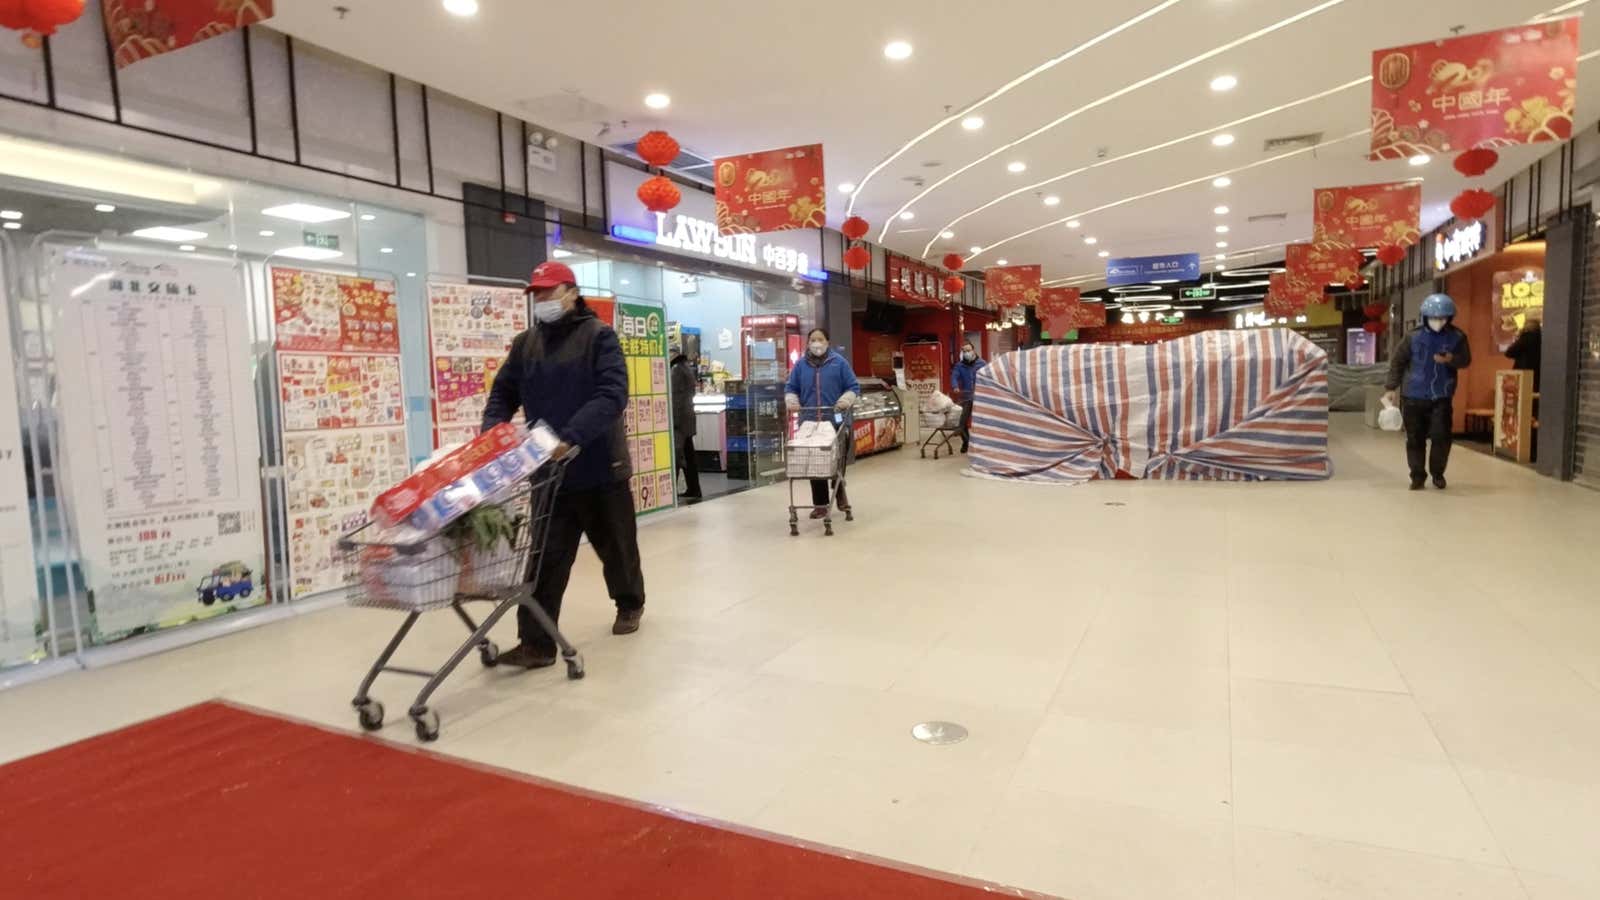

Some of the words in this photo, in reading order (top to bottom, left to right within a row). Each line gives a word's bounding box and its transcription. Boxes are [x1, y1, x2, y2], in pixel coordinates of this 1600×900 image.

[1432, 88, 1512, 113] 中國年
[747, 189, 793, 205] 中國年
[656, 211, 757, 264] LAWSON
